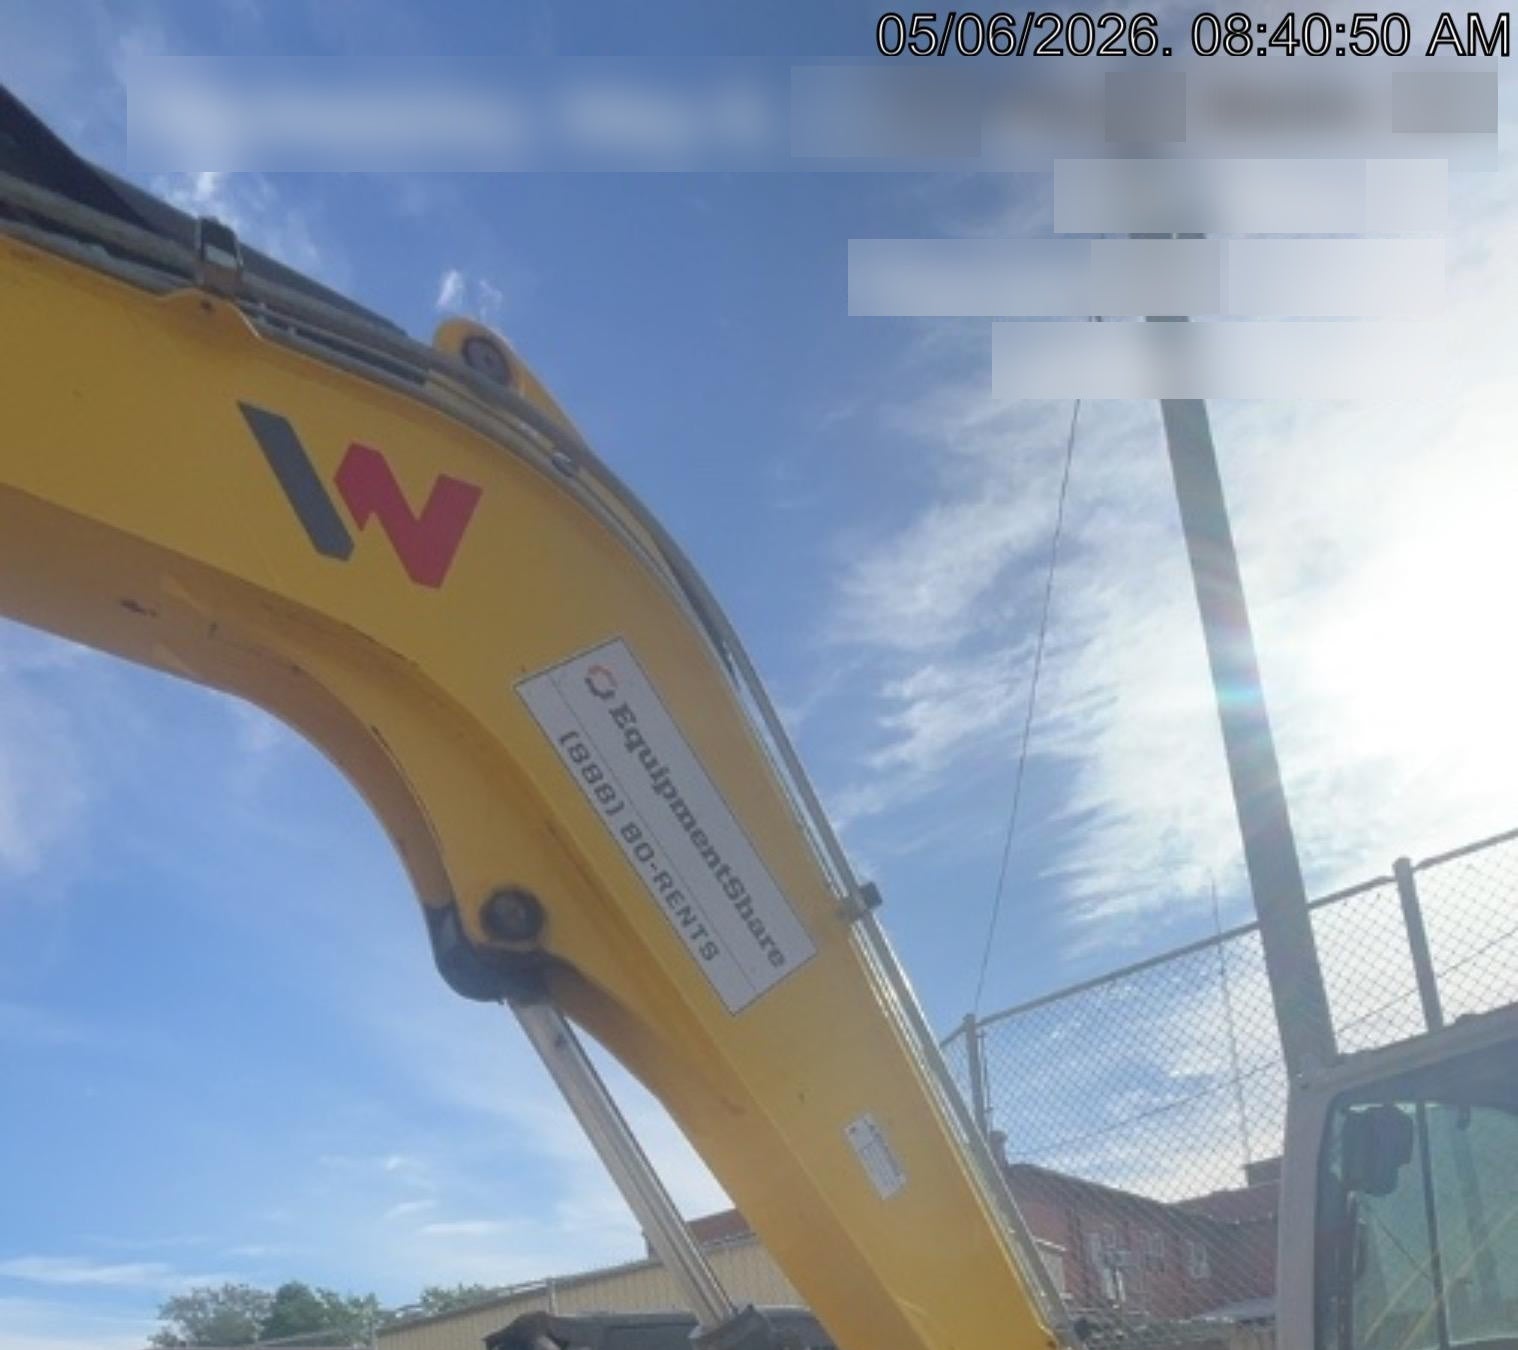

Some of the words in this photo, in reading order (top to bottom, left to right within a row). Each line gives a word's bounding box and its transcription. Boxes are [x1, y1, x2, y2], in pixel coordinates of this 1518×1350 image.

[559, 730, 625, 816] (888)
[620, 822, 719, 961] 80-RENTS
[609, 702, 785, 968] EquipmentShare
